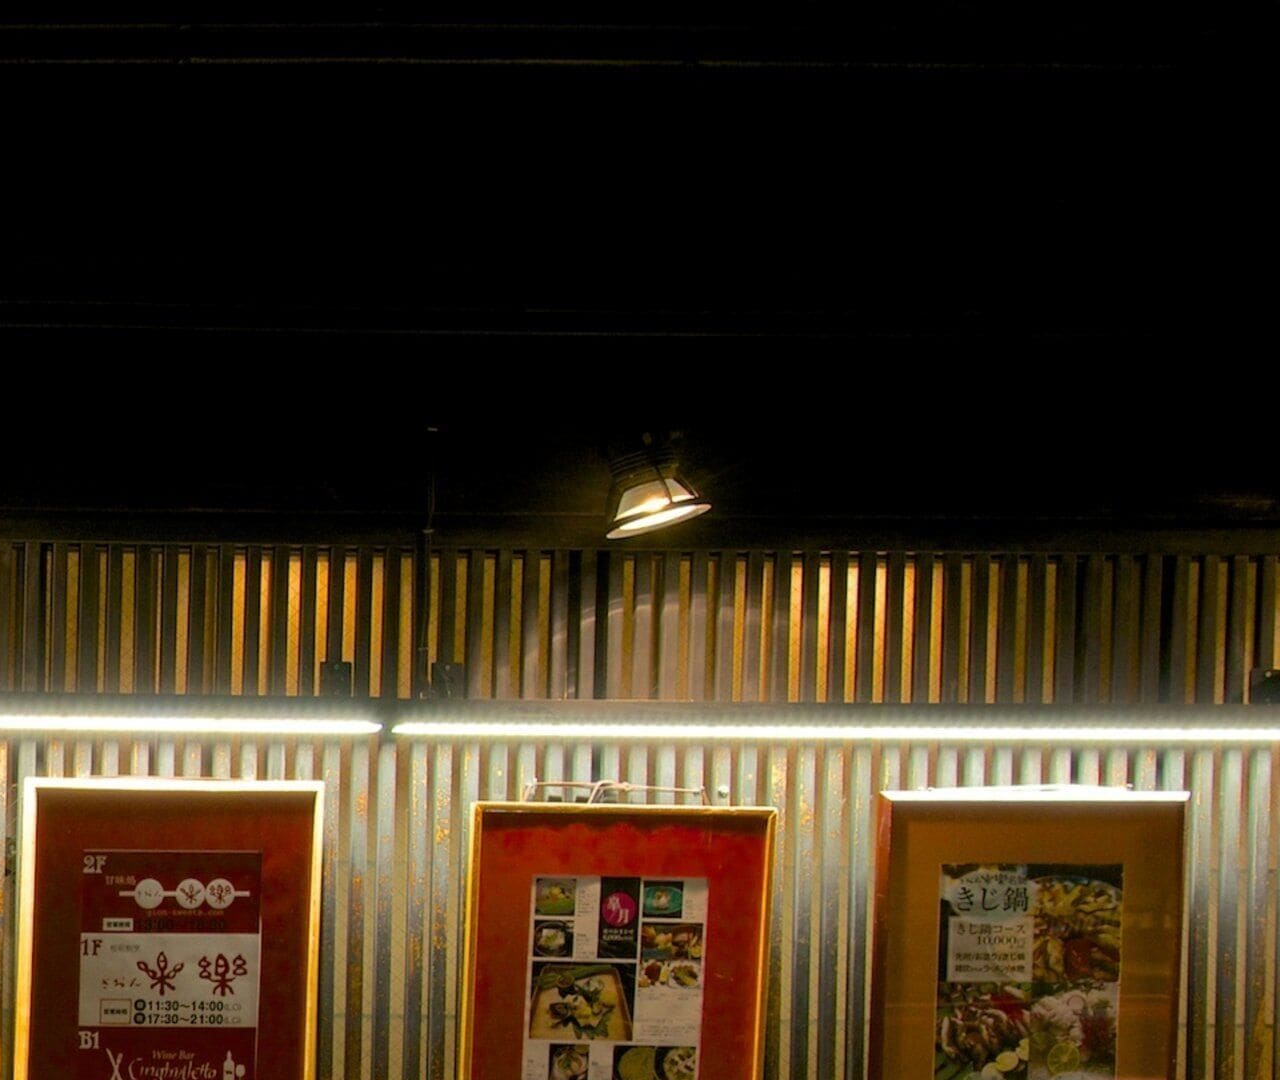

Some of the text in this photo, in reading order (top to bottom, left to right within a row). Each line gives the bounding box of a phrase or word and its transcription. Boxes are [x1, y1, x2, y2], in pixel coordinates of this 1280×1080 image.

[82, 854, 108, 875] 2F
[957, 886, 1029, 912] きじ鍋
[956, 923, 1026, 936] きじ鍋コース
[80, 939, 103, 956] 1F
[78, 1031, 100, 1050] B1
[152, 1049, 196, 1061] Wine Bar
